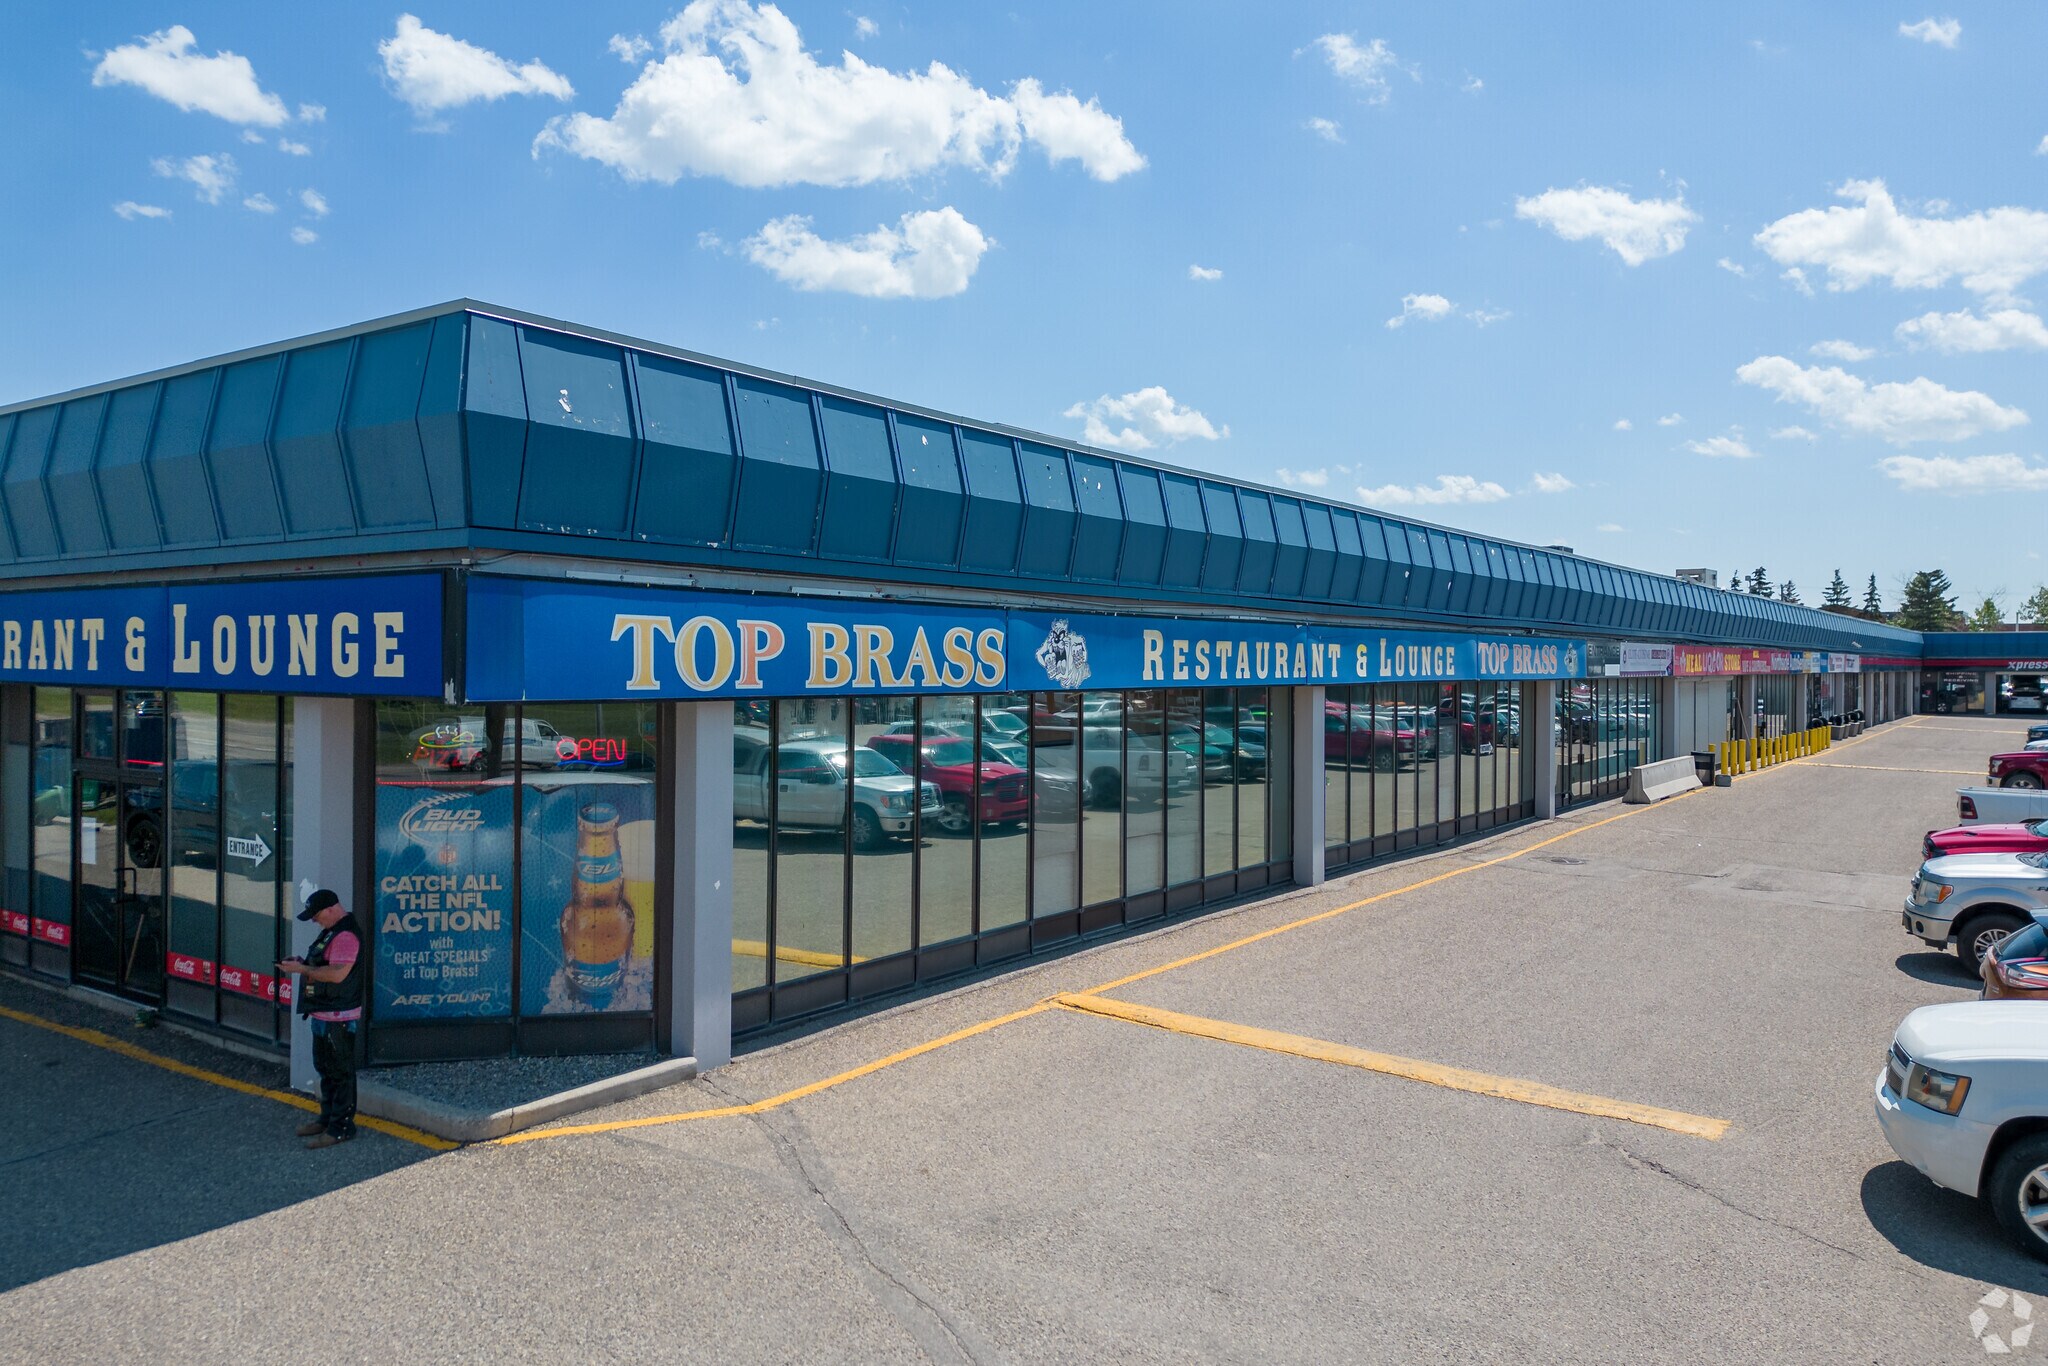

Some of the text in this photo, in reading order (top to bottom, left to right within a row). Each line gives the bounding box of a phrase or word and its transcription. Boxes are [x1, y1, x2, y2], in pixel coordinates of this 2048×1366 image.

[125, 616, 146, 672] &
[172, 603, 404, 678] LOUNGE
[610, 614, 1006, 692] TOP BRASS
[1142, 629, 1456, 682] RESTAURANT & LOUNGE
[1478, 642, 1509, 674] TOP
[1513, 644, 1558, 674] BRASS
[1724, 653, 1741, 671] STORE
[555, 738, 627, 761] OPEN
[423, 809, 481, 820] BUD
[410, 820, 485, 832] LIGHT
[230, 840, 263, 857] ENTRANCE
[381, 874, 503, 893] CATCH ALL
[396, 892, 487, 910] THE NFL
[381, 910, 501, 933] ACTION!
[430, 936, 454, 949] with
[394, 949, 488, 965] GREAT SPECIALS
[403, 965, 478, 980] at Top Brass!
[391, 994, 434, 1006] ARE
[436, 993, 470, 1005] YOU
